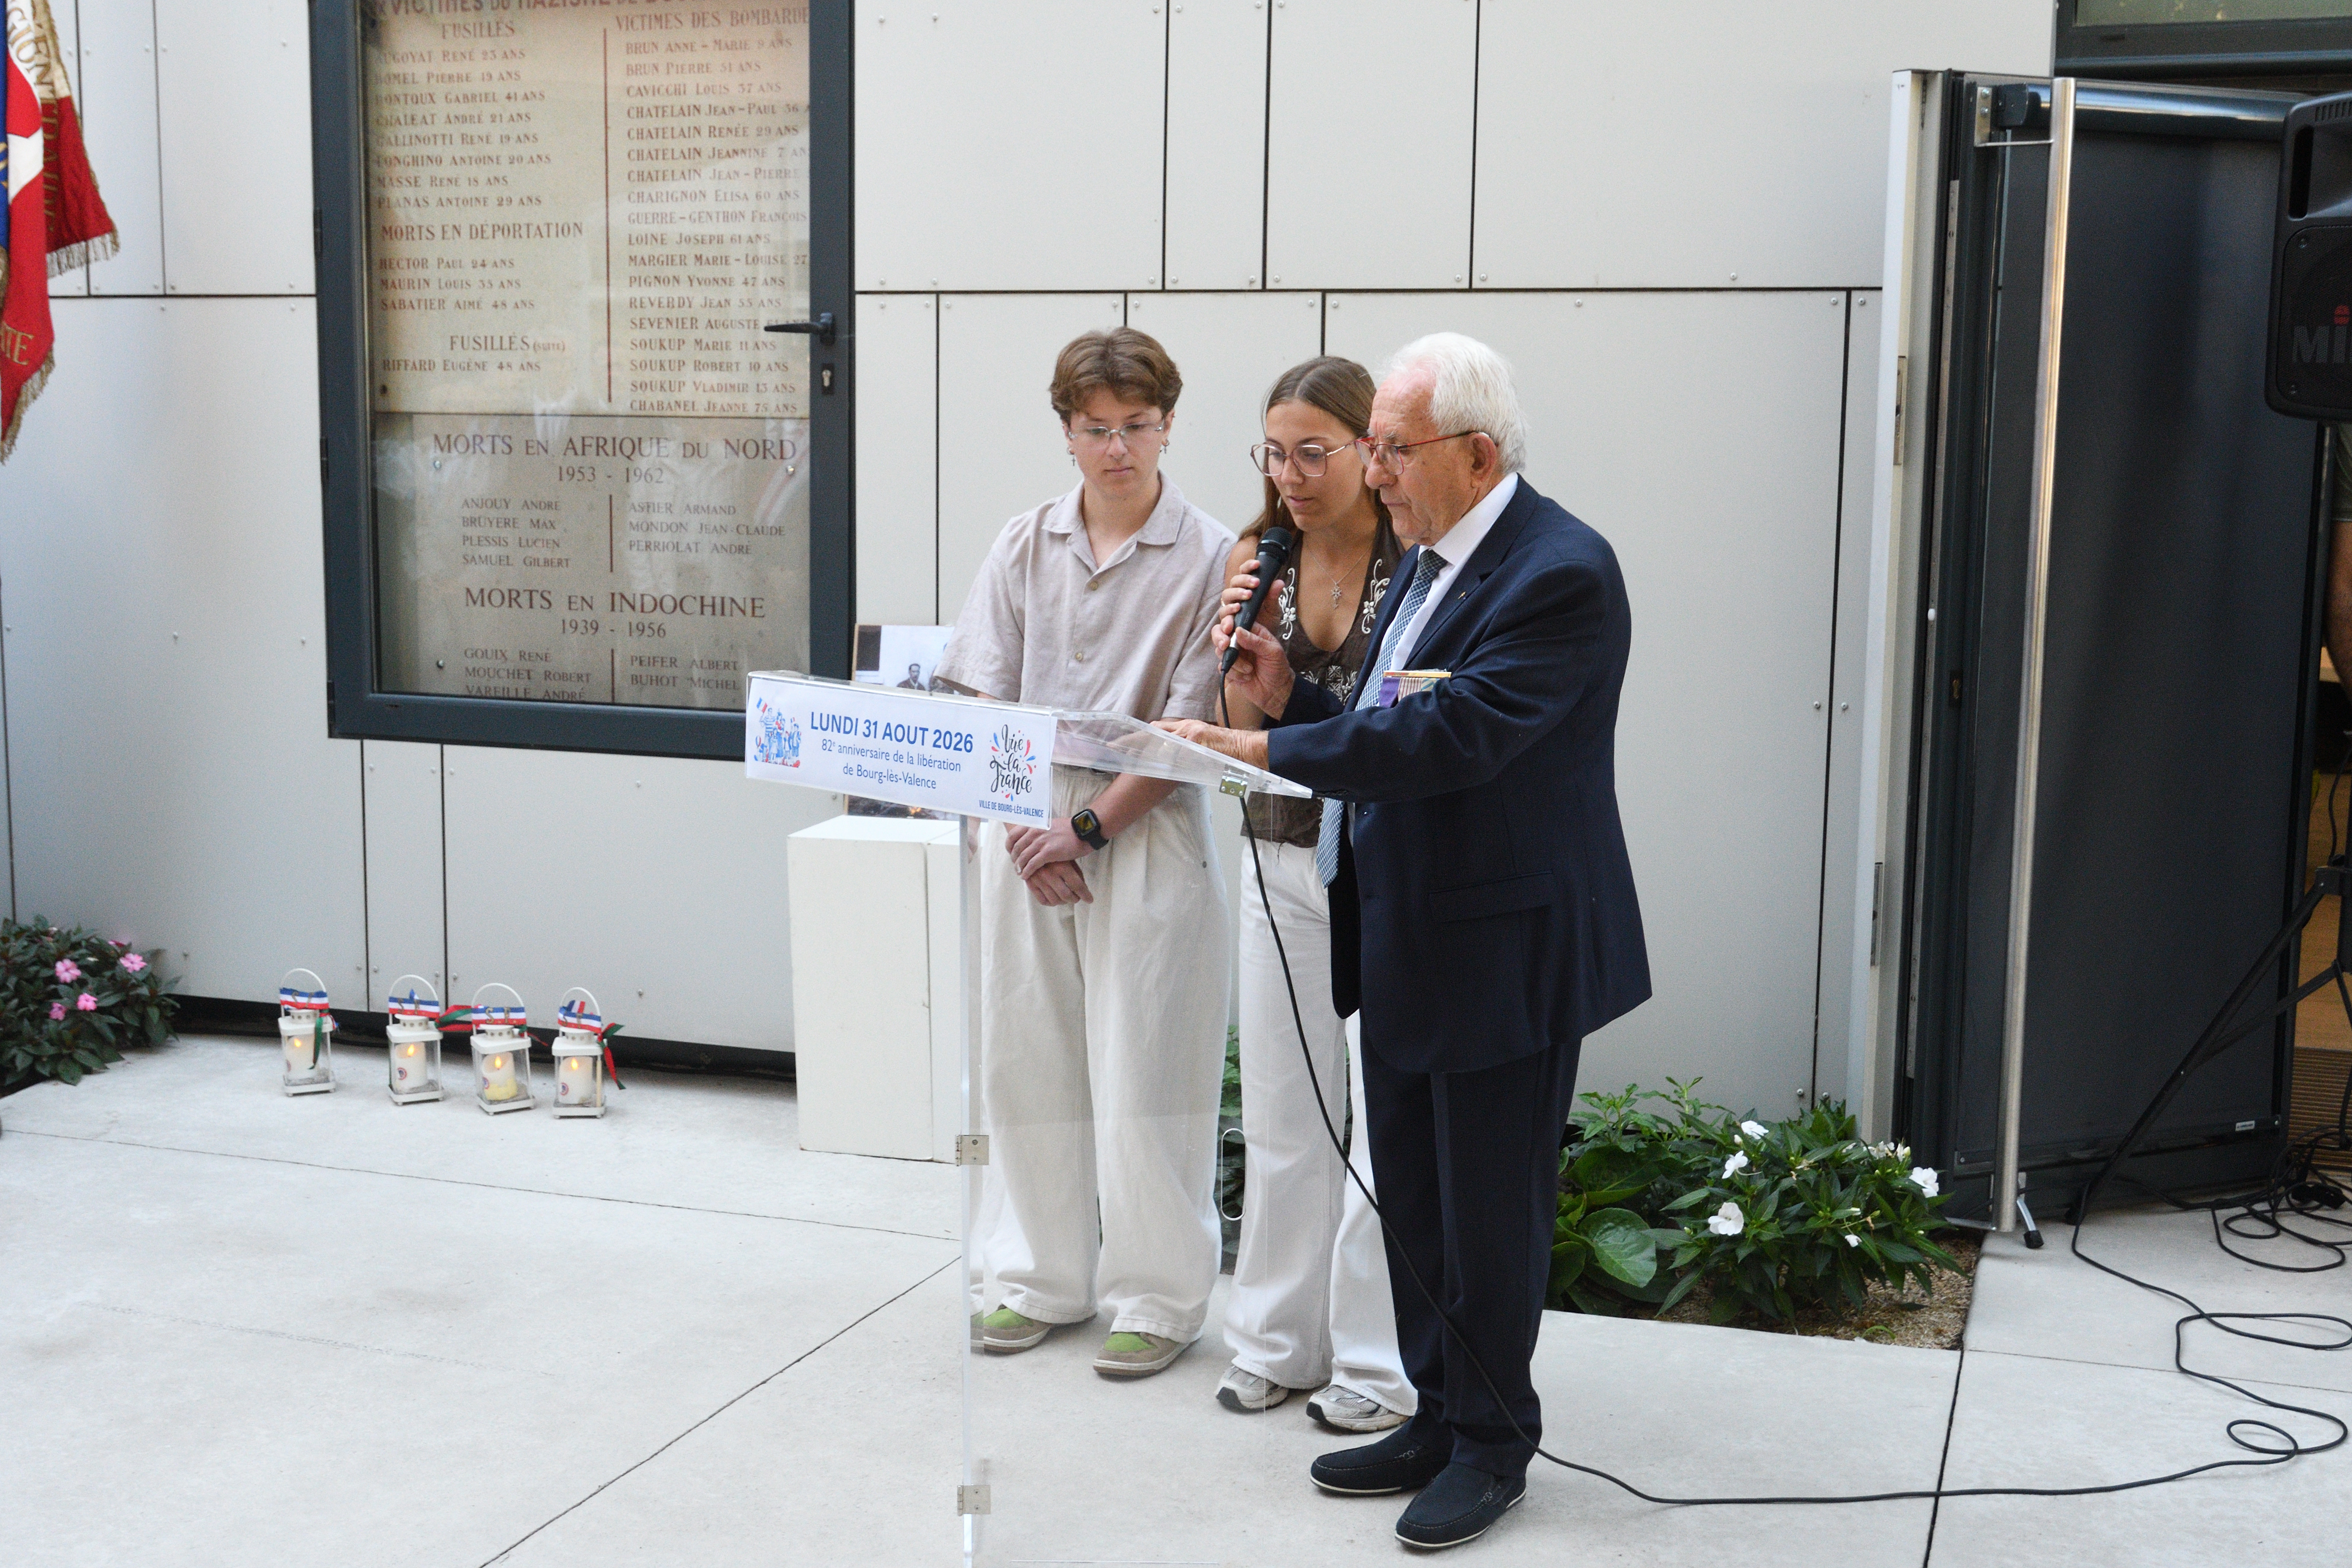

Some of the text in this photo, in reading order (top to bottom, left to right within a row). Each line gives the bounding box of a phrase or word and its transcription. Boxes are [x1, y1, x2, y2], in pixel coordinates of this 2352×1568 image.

[615, 13, 683, 31] VICTIMES
[691, 12, 721, 28] DES
[626, 38, 792, 55] BRUN ANS
[442, 49, 525, 61] RENÉ ANS
[626, 63, 659, 76] BRUN
[666, 63, 713, 75] PIERRE
[740, 62, 761, 72] ANS
[427, 71, 521, 83] PIERRE 19 ANS
[626, 84, 686, 97] CAVICCHI
[696, 83, 730, 95] LOUIS
[760, 83, 782, 93] ANS
[445, 91, 545, 104] GABRIEL 41 ANS
[490, 114, 504, 123] 21
[508, 113, 531, 122] ANS
[627, 105, 701, 119] CHATELAIN
[500, 135, 510, 144] 19
[515, 134, 539, 144] ANS
[627, 124, 799, 141] CHATELAIN RENÉE 29 ANS
[449, 154, 551, 166] ANTOINE 20 ANS
[628, 147, 701, 161] CHATELAIN
[778, 147, 785, 157] 7
[486, 176, 508, 186] ANS
[628, 169, 702, 182] CHATELAIN
[436, 197, 489, 207] ANTOINE
[497, 196, 513, 206] 29
[518, 196, 542, 205] ANS
[628, 191, 707, 203] CHARIGNON
[755, 191, 770, 200] 60
[776, 190, 800, 200] ANS
[381, 220, 583, 242] MORTS EN DÉPORTATION
[629, 233, 770, 245] LOINE JOSEPH 61 ANS
[381, 258, 515, 270] HECTOR PAUL 24 ANS
[629, 254, 687, 266] MARGIER
[381, 279, 521, 291] MAURIN LOUIS ANS
[629, 275, 785, 287] PIGNON YVONNE 47 ANS
[381, 299, 446, 311] SABATIER
[513, 300, 534, 309] ANS
[629, 297, 781, 309] REVERDY JEAN ANS
[630, 317, 698, 329] SEVENIER
[705, 318, 759, 329] AUGUSTE
[450, 333, 529, 351] FUSILLÉS
[630, 339, 685, 351] SOUKUP
[693, 339, 732, 351] MARIE
[753, 340, 777, 350] ANS
[383, 360, 436, 372] RIFFARD
[520, 361, 541, 371] ANS
[631, 360, 789, 372] SOUKUP ROBERT 10 ANS
[631, 381, 795, 393] SOUKUP VLADIMIR ANS
[631, 400, 798, 413] CHABANEL JEANNE ANS
[433, 434, 797, 460] MORTS EN AFRIQUE DU NORD
[558, 466, 664, 483] 1953 1962
[463, 499, 512, 509] ANJOUY
[629, 502, 736, 515] ASTIER ARMAND
[530, 519, 556, 530] MAX
[629, 522, 689, 533] MONDON
[463, 535, 560, 548] PLESSIS LUCIEN
[629, 541, 751, 554] PERRIOLAT ANDRÉ
[463, 554, 570, 568] SAMUEL GILBERT
[465, 587, 765, 618] MORTS EN INDOCHINE
[561, 619, 666, 638] 1939 1956
[465, 648, 550, 662] GOUIX RENÉ
[631, 655, 739, 670] PEIFER ALBERT
[465, 667, 590, 683] MOUCHET ROBERT
[631, 675, 740, 690] BUHOT MICHEL
[543, 688, 585, 700] ANDRÉ
[811, 712, 973, 753] LUNDI 31 AOUT 2026
[1002, 724, 1023, 753] Vive
[838, 745, 890, 760] anniversaire
[893, 750, 904, 763] de
[907, 752, 914, 765] la
[917, 753, 961, 772] libération
[1004, 753, 1021, 772] la
[843, 762, 936, 789] de Bourg-lès-Valence
[990, 755, 1032, 795] France
[979, 800, 990, 808] VILLE
[998, 803, 1043, 818] BOURG-LÈS-VALENCE
